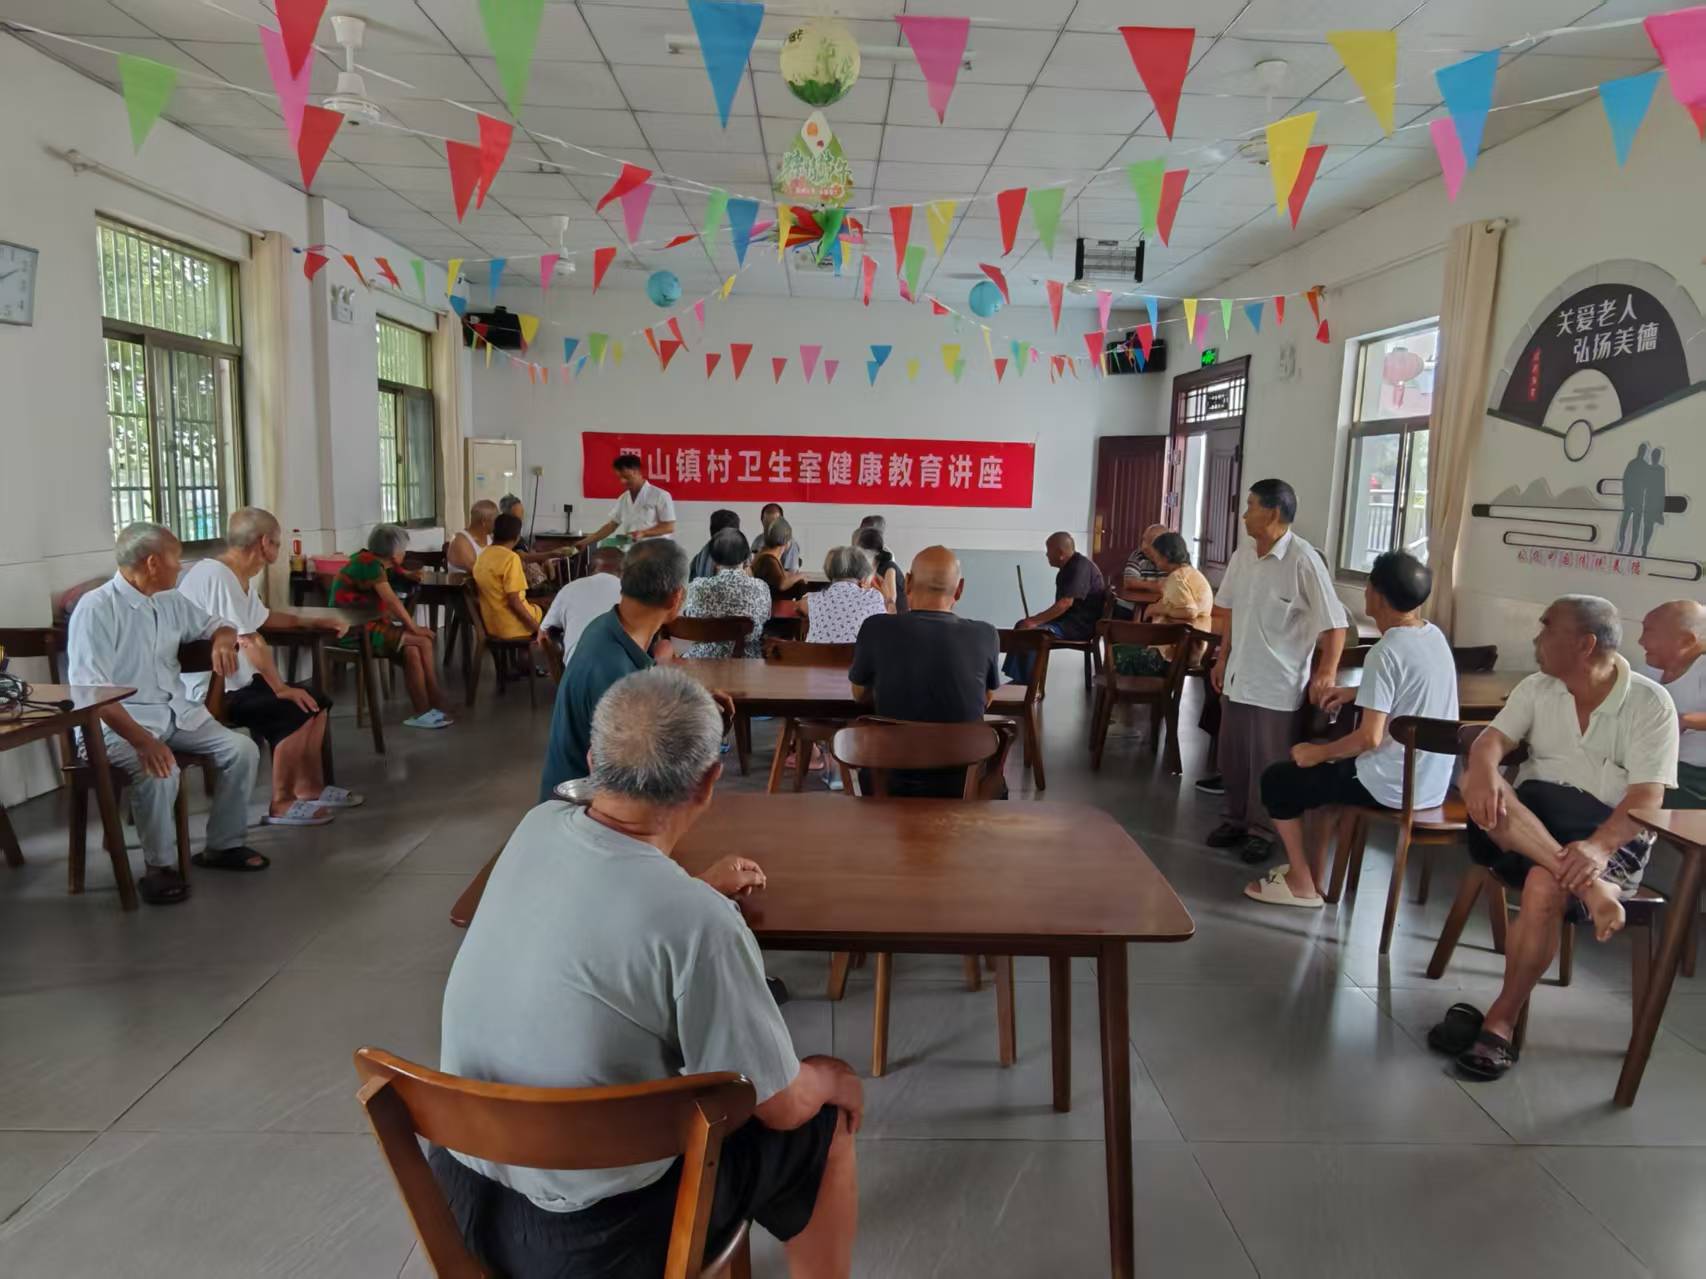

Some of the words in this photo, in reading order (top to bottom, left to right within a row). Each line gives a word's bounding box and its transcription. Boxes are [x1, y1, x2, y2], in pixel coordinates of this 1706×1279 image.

[1556, 293, 1638, 337] 关爱老人
[1573, 321, 1659, 363] 弘扬美德
[620, 447, 1003, 489] 山镇村卫生室健康教育讲座
